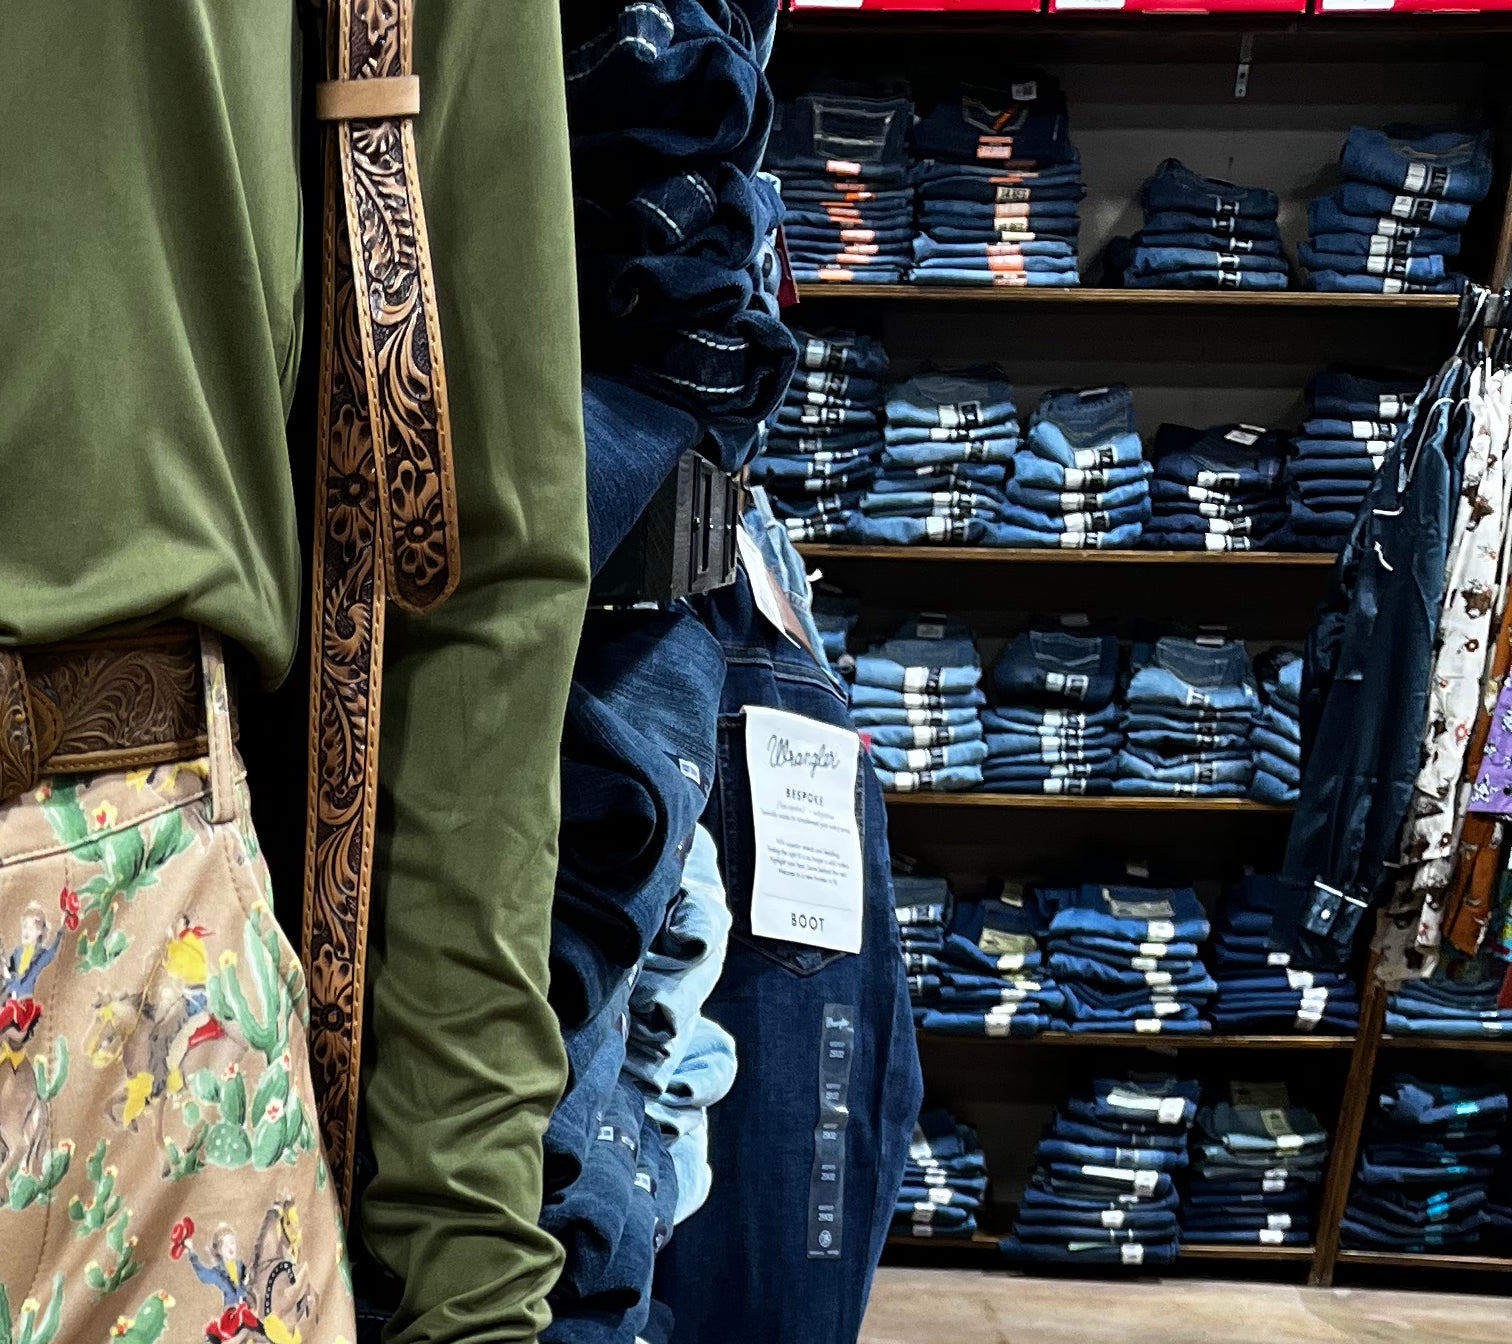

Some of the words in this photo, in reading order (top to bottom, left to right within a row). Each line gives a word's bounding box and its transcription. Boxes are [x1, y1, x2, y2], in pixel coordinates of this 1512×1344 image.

[767, 734, 840, 778] Wrangler
[786, 788, 824, 807] BESPOKE
[791, 912, 825, 933] BOOT
